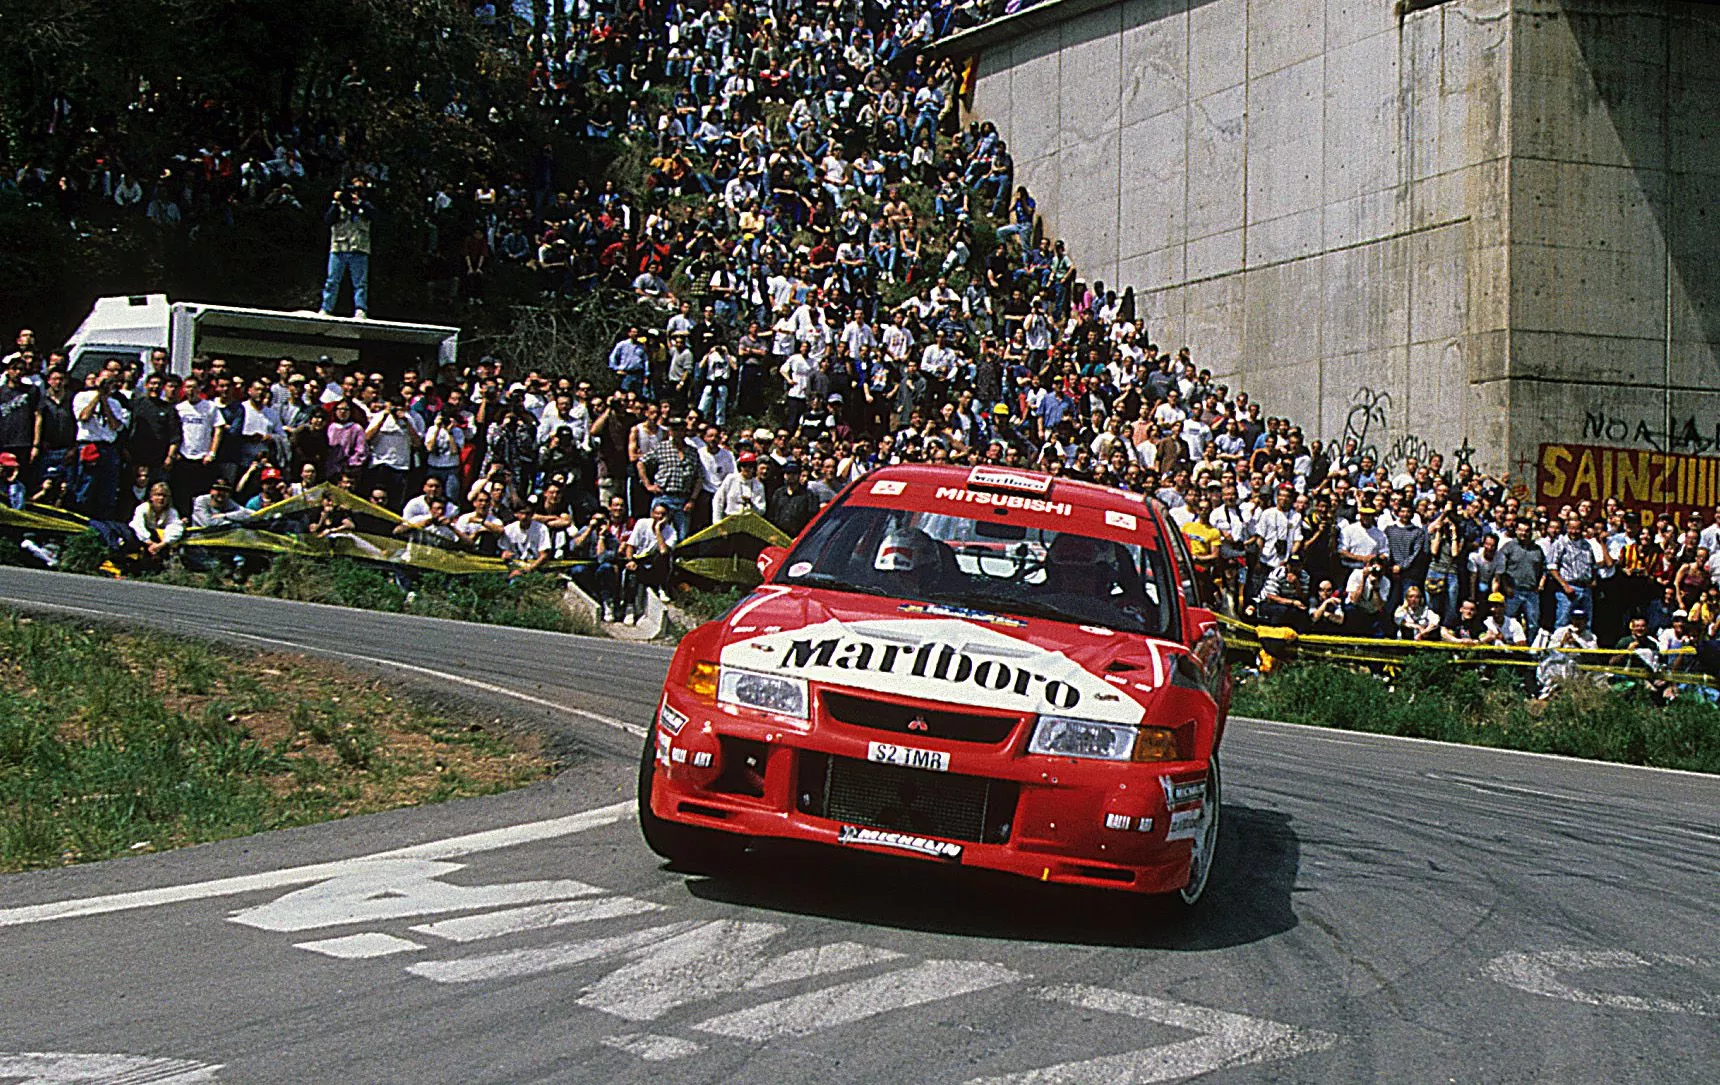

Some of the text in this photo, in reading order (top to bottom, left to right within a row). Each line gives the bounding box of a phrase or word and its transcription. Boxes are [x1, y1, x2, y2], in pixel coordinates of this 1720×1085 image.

[974, 475, 1044, 489] Marlboro
[935, 487, 1072, 516] MITSUBISHI
[778, 636, 1081, 709] Marlboro
[876, 744, 942, 769] S2 TMR
[858, 829, 961, 857] MICHELIN
